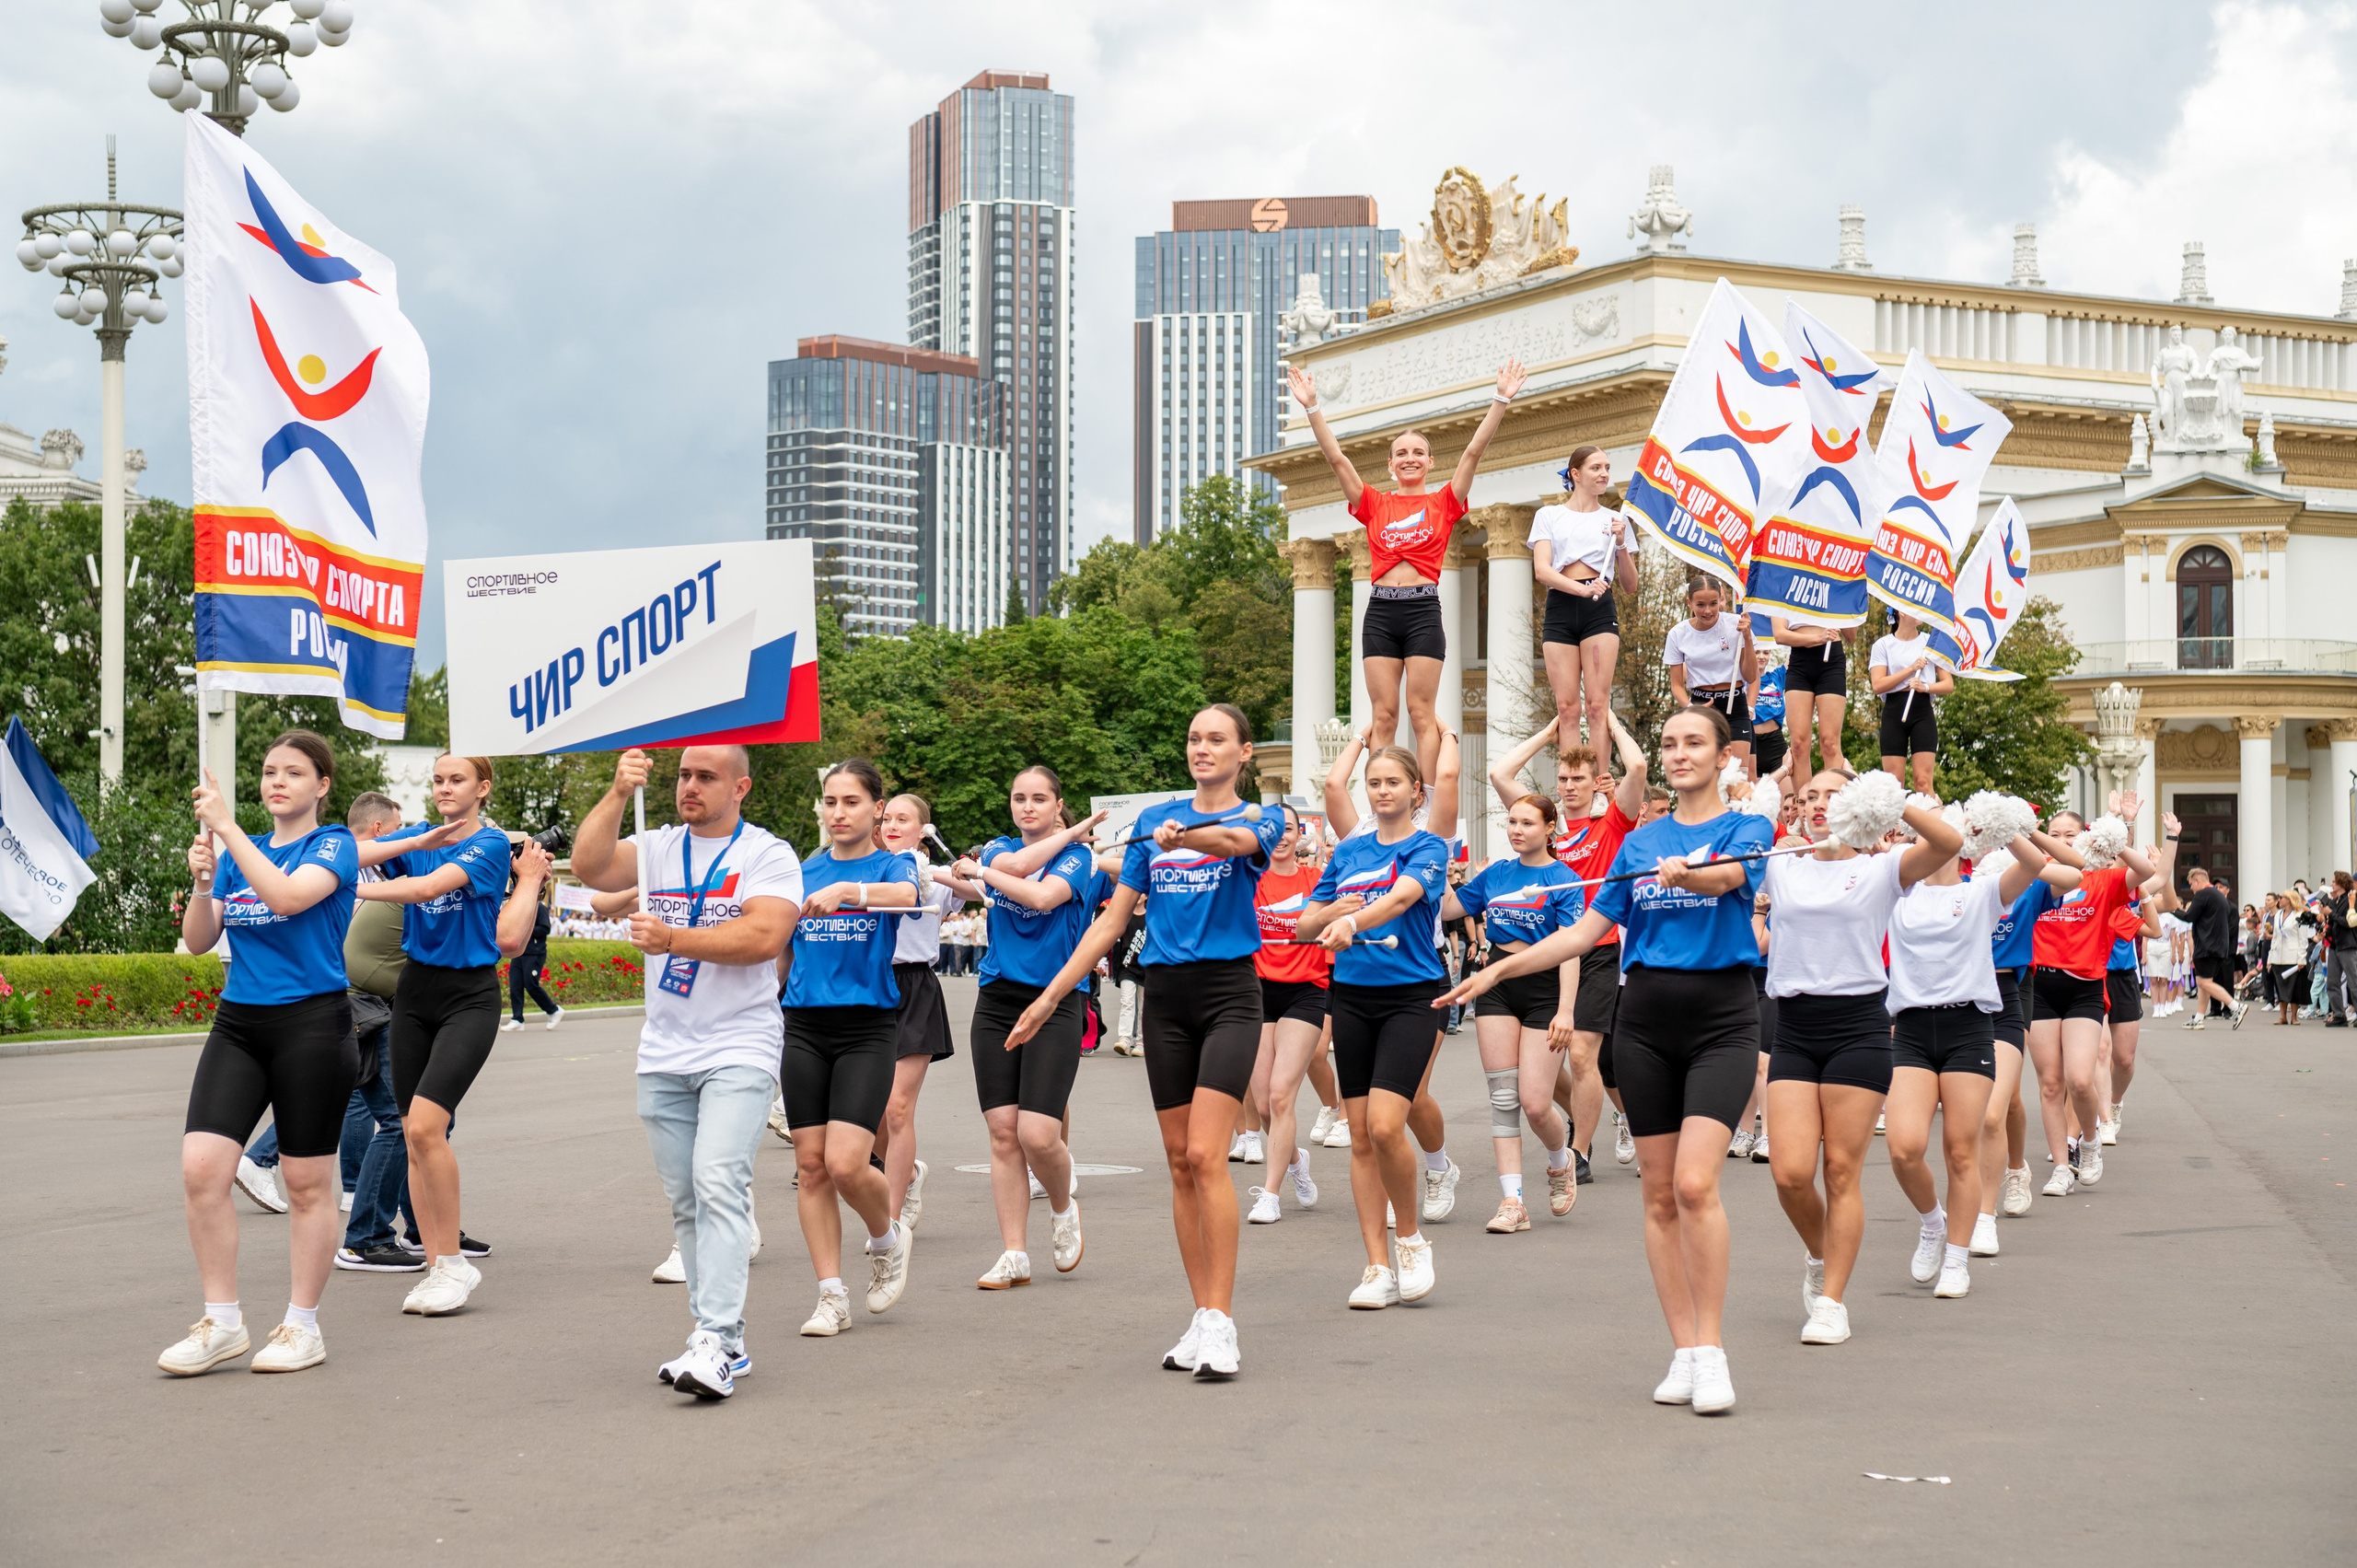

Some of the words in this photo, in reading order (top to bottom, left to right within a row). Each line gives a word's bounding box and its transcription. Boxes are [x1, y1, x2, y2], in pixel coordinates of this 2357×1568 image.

[1687, 484, 1717, 518] ЧИР
[1768, 528, 1803, 559] СОЮЗ
[1900, 538, 1926, 564] ЧИР
[226, 530, 299, 579] СОЮЗ
[325, 563, 404, 627] СПОРТА
[468, 587, 537, 598] ШЕСТВИЕ
[1881, 563, 1937, 607] РОССИИ
[509, 646, 585, 735] ЧИР
[597, 559, 722, 688] СПОРТ
[1640, 897, 1718, 911] ШЕСТВИЕ
